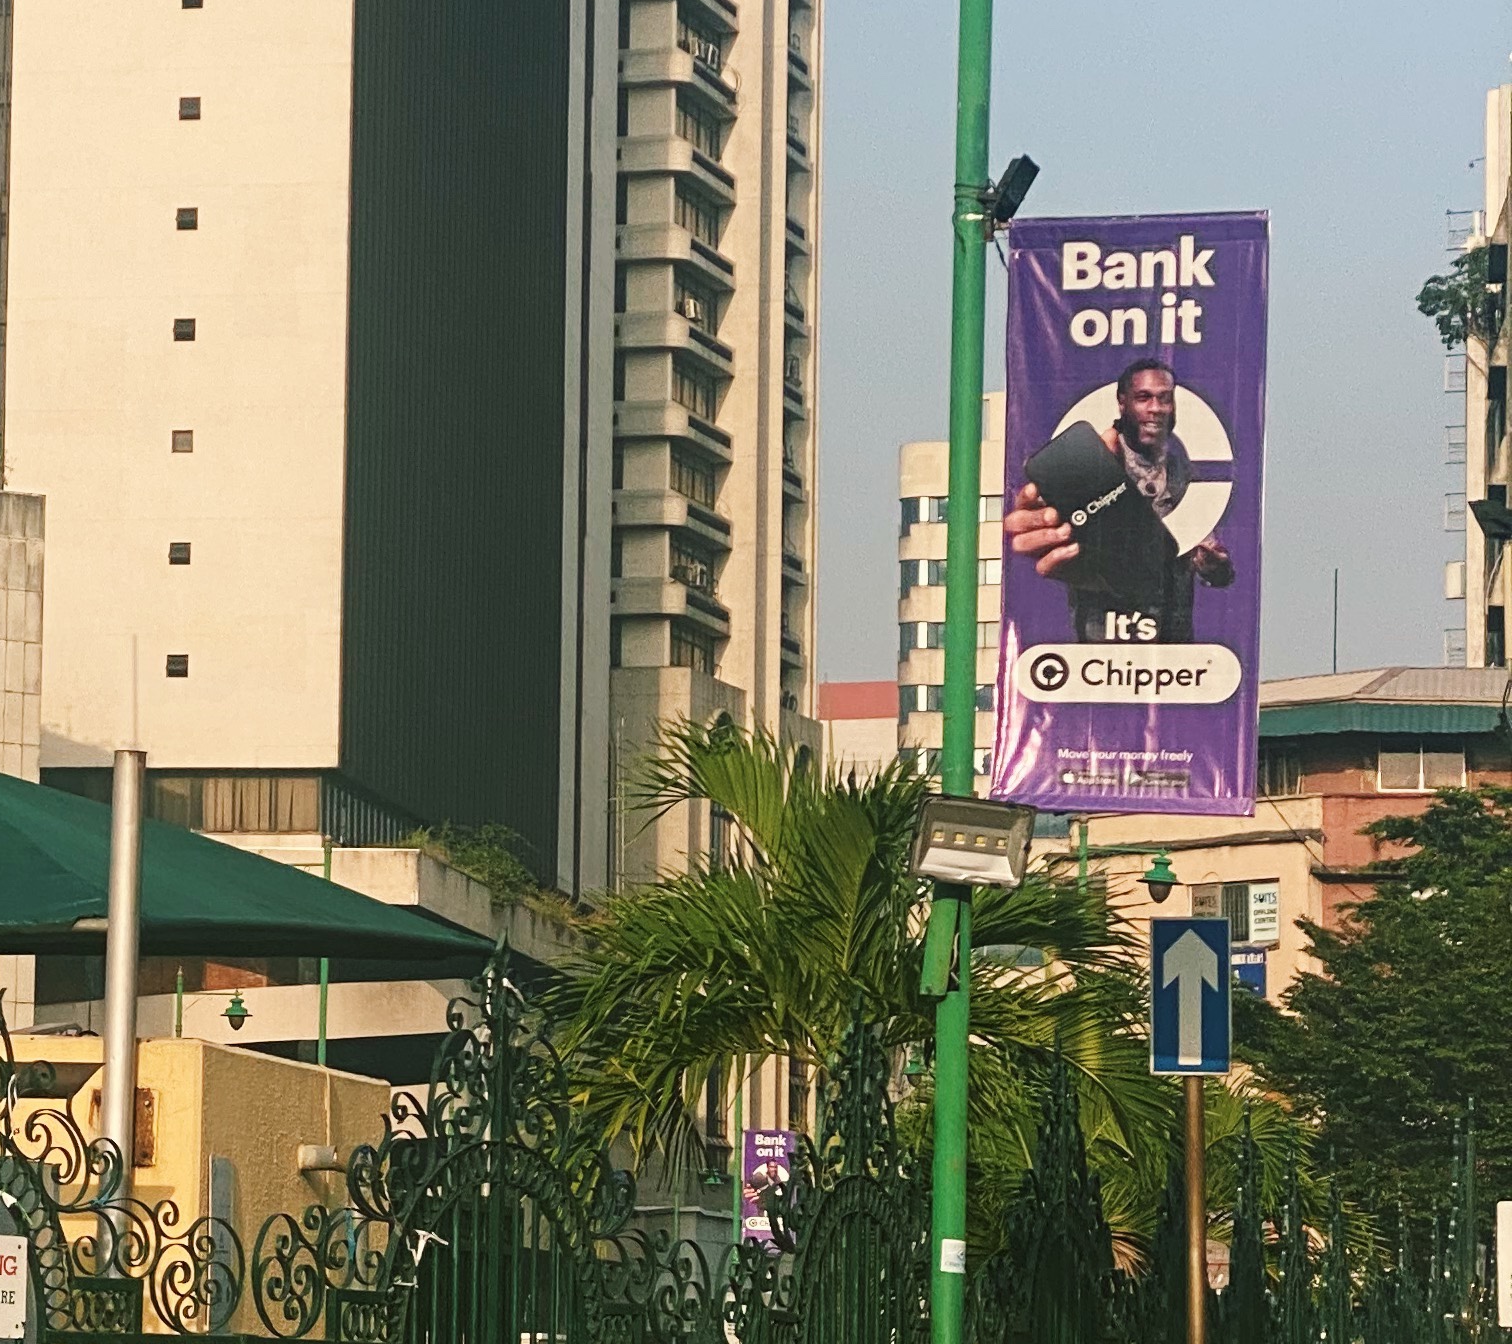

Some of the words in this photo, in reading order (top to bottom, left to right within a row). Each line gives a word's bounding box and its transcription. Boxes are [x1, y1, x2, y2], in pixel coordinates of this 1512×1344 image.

[1062, 235, 1216, 290] Bank
[1070, 307, 1148, 347] on
[1161, 292, 1202, 344] it
[1104, 611, 1158, 640] It's
[1081, 659, 1208, 695] Chipper
[1057, 748, 1089, 759] Move
[1119, 751, 1159, 762] money
[1160, 749, 1193, 763] freely
[754, 1133, 787, 1146] Bank
[756, 1147, 774, 1157] on
[774, 1145, 785, 1157] it
